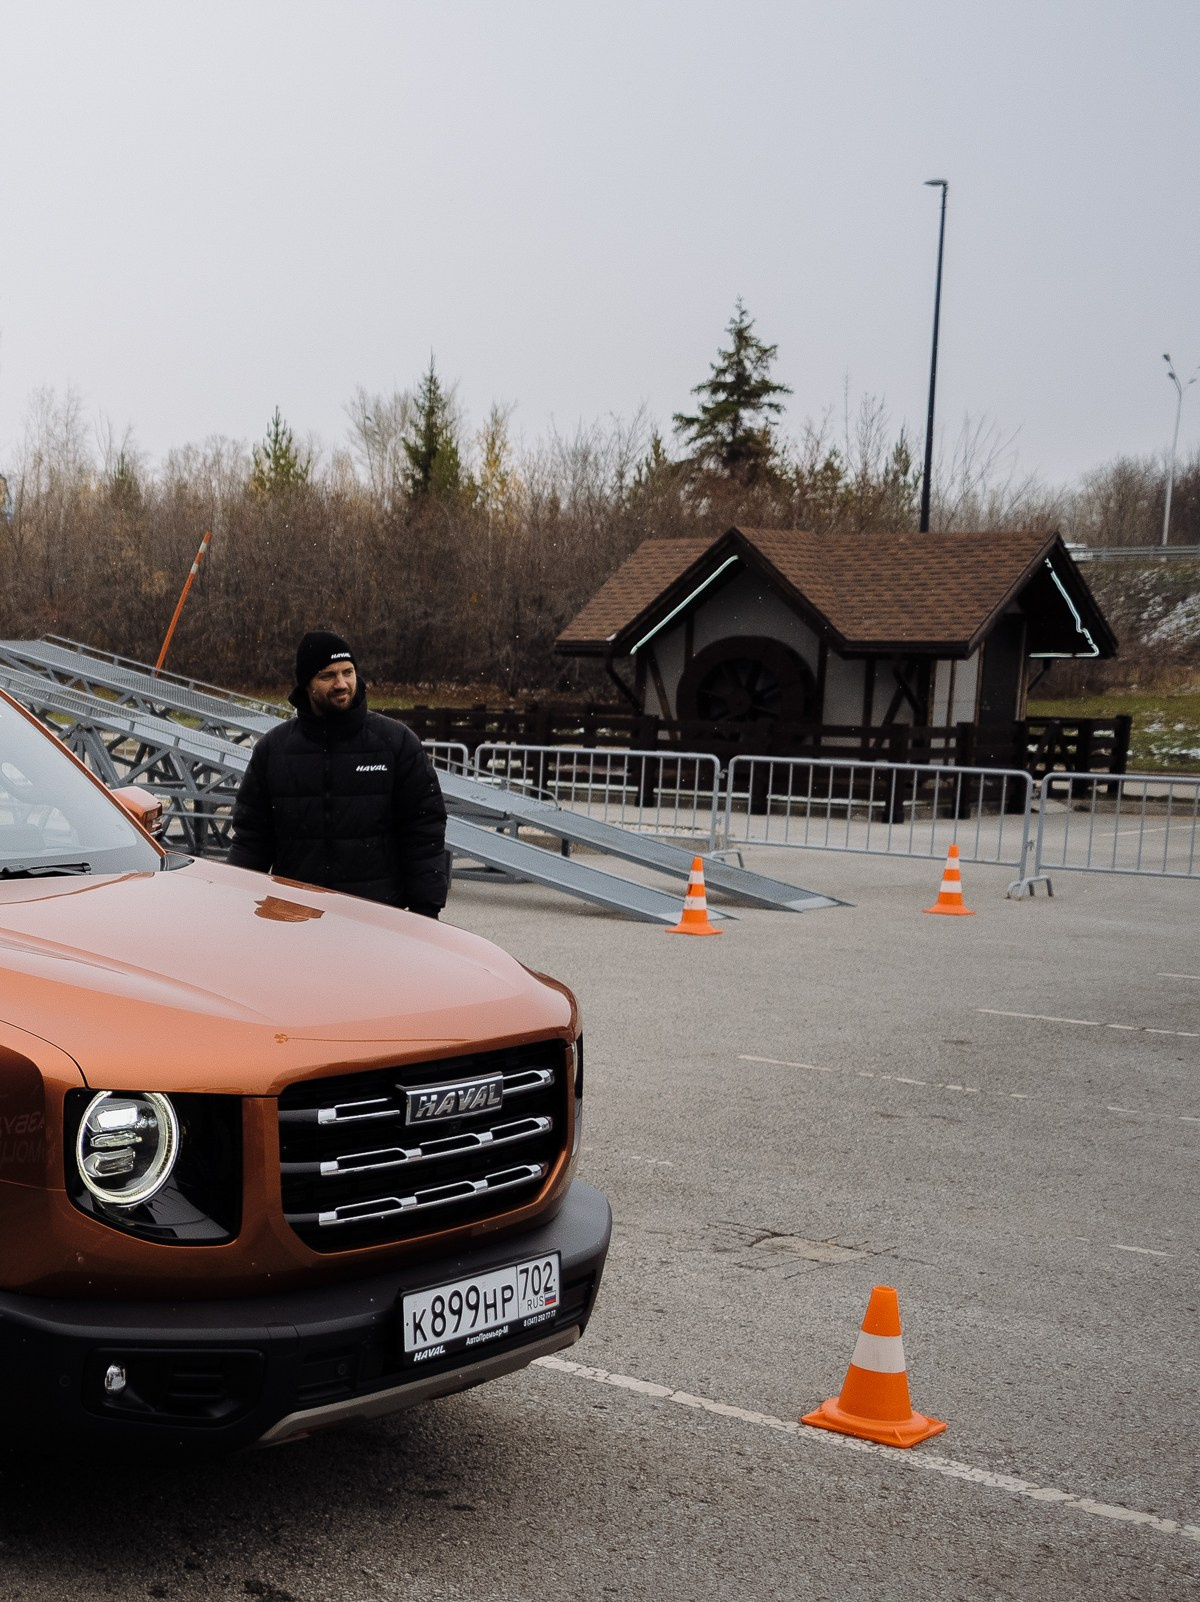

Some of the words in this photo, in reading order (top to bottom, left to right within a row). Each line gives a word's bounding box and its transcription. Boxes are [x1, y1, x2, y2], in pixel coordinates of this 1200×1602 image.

[356, 764, 387, 772] HAVAL
[415, 1083, 500, 1118] HAVAL
[413, 1284, 514, 1345] К899НР
[519, 1261, 554, 1301] 702
[527, 1294, 545, 1311] RUS
[465, 1325, 509, 1346] АвтоПремьер-М
[413, 1345, 446, 1362] HAVAL
